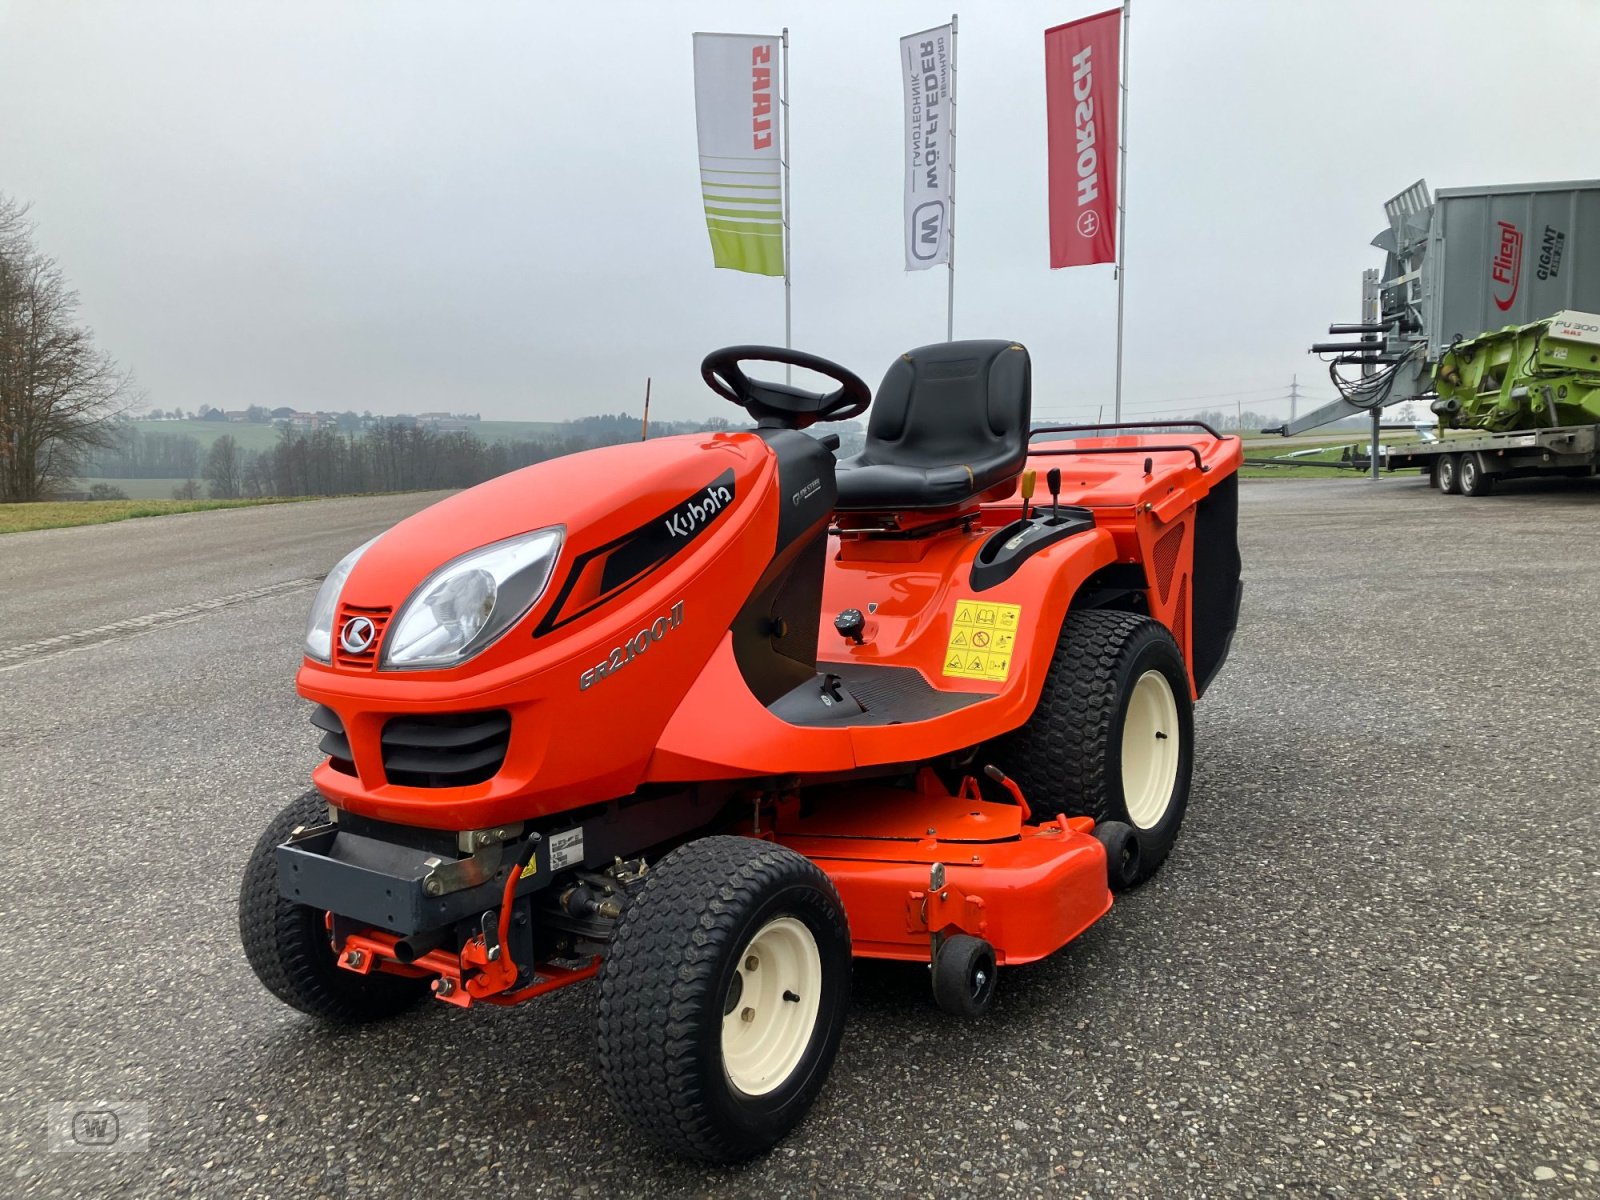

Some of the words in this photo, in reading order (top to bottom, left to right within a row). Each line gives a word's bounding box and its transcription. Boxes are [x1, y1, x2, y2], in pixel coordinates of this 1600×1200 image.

[1493, 220, 1518, 284] Fliegl
[1537, 224, 1557, 280] GIGANT
[1573, 322, 1599, 332] 300
[665, 484, 732, 536] Kubota
